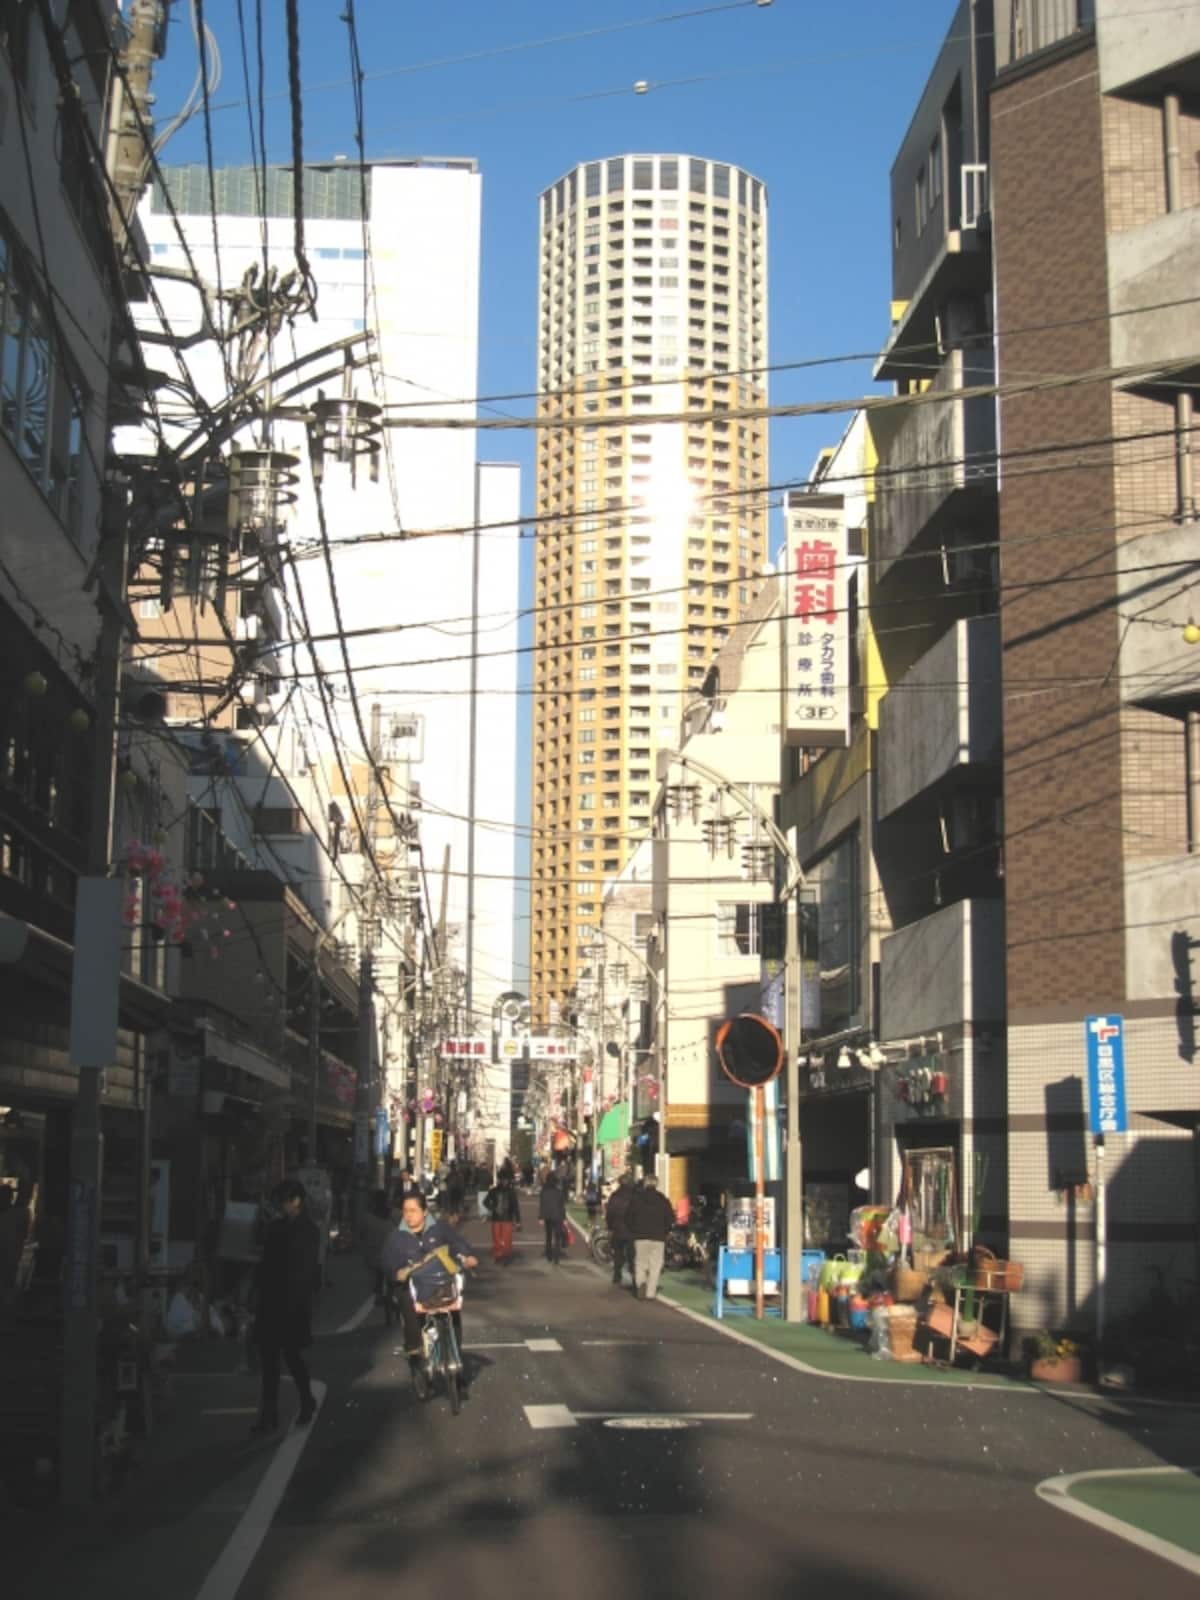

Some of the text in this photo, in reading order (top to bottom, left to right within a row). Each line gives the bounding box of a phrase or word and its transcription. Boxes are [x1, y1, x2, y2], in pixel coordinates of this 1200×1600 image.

[794, 539, 838, 625] 歯科
[797, 631, 813, 697] 診療所
[820, 631, 836, 698] タカラ歯科
[805, 706, 828, 720] 3F
